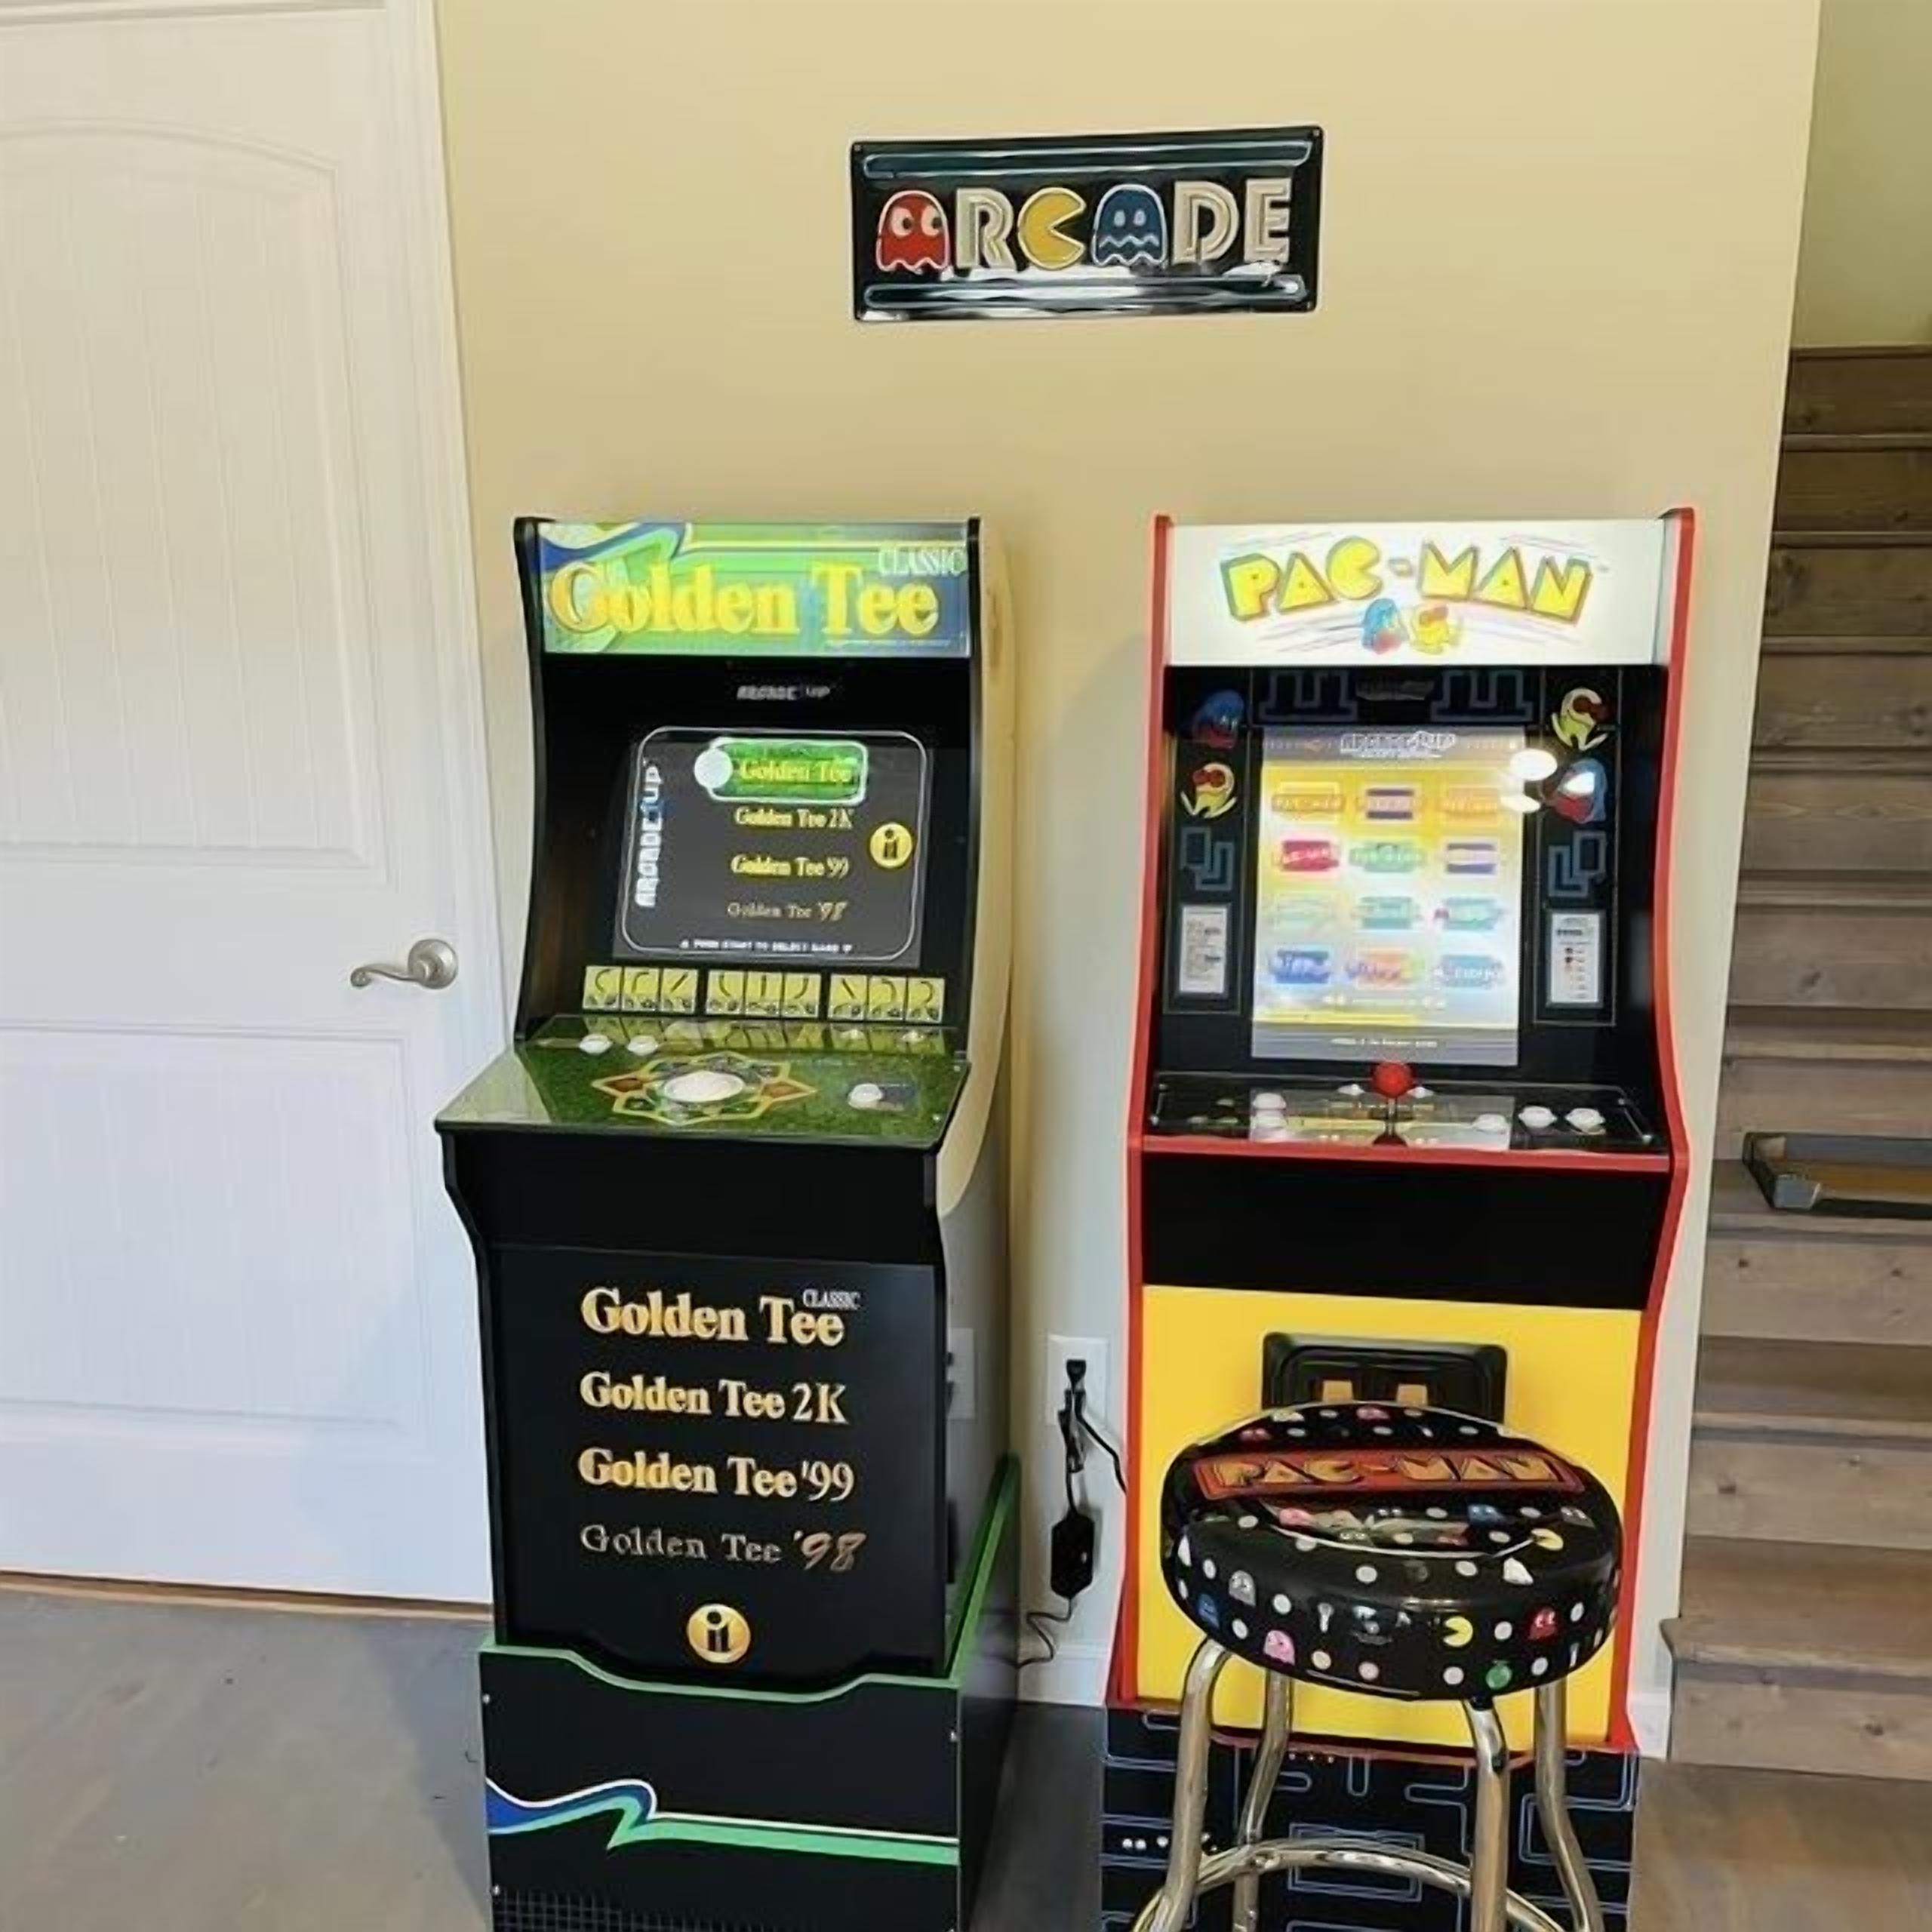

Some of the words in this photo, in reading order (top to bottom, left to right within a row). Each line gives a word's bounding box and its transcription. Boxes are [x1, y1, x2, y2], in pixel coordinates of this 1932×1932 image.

[875, 177, 1291, 272] ARCADE
[878, 547, 967, 576] CLASSIC
[1220, 536, 1594, 623] PAC-MAN
[549, 561, 800, 635] Golden
[811, 564, 939, 635] Tee
[738, 758, 810, 782] Golden
[735, 806, 792, 827] Golden
[731, 854, 792, 876] Golden
[794, 856, 825, 876] Tee
[580, 1287, 749, 1342] Golden
[759, 1295, 845, 1346] Tee
[802, 1289, 860, 1310] CLASSIC
[580, 1371, 712, 1416] Golden
[718, 1379, 786, 1419] Tee
[791, 1383, 851, 1426] 2K
[577, 1447, 718, 1494] Golden
[726, 1456, 798, 1497] Tee
[801, 1460, 854, 1502] '99
[1209, 1452, 1565, 1487] PAC-MAN
[579, 1524, 707, 1561] Golden
[721, 1533, 782, 1563] Tee
[792, 1530, 867, 1573] '98
